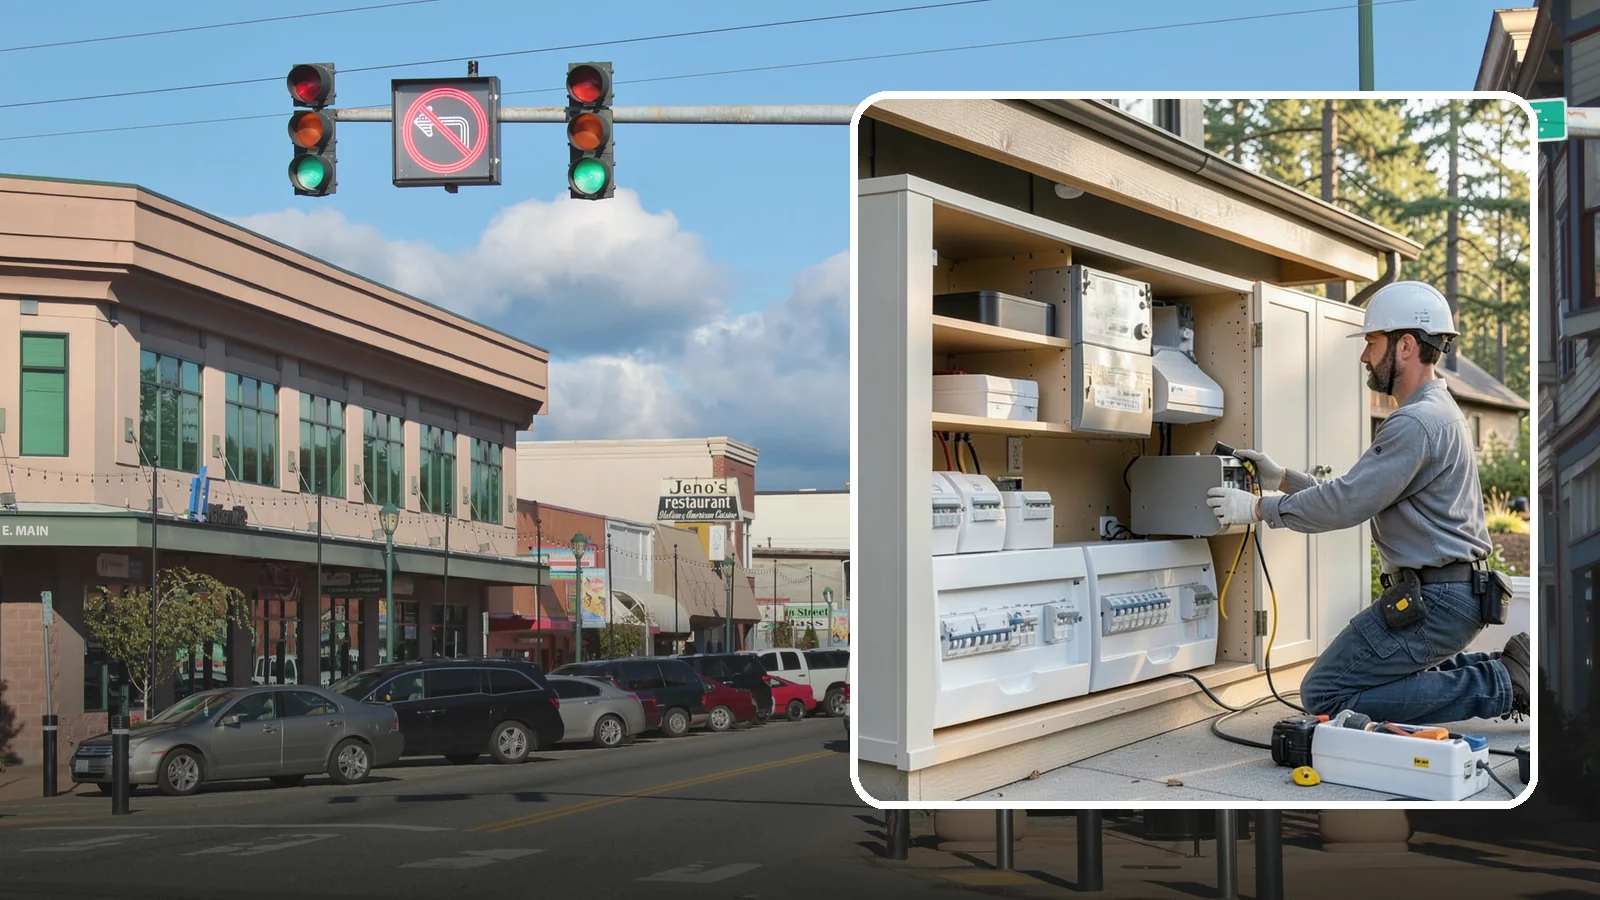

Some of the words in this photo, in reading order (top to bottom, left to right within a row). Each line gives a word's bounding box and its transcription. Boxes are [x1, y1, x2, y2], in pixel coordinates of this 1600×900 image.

[670, 480, 727, 494] Jeno's
[665, 496, 731, 509] restaurant
[659, 510, 681, 519] Italian
[686, 510, 714, 519] American
[715, 509, 737, 519] Cuisine
[2, 525, 13, 536] E.
[15, 525, 49, 536] MAIN
[797, 607, 828, 617] Street
